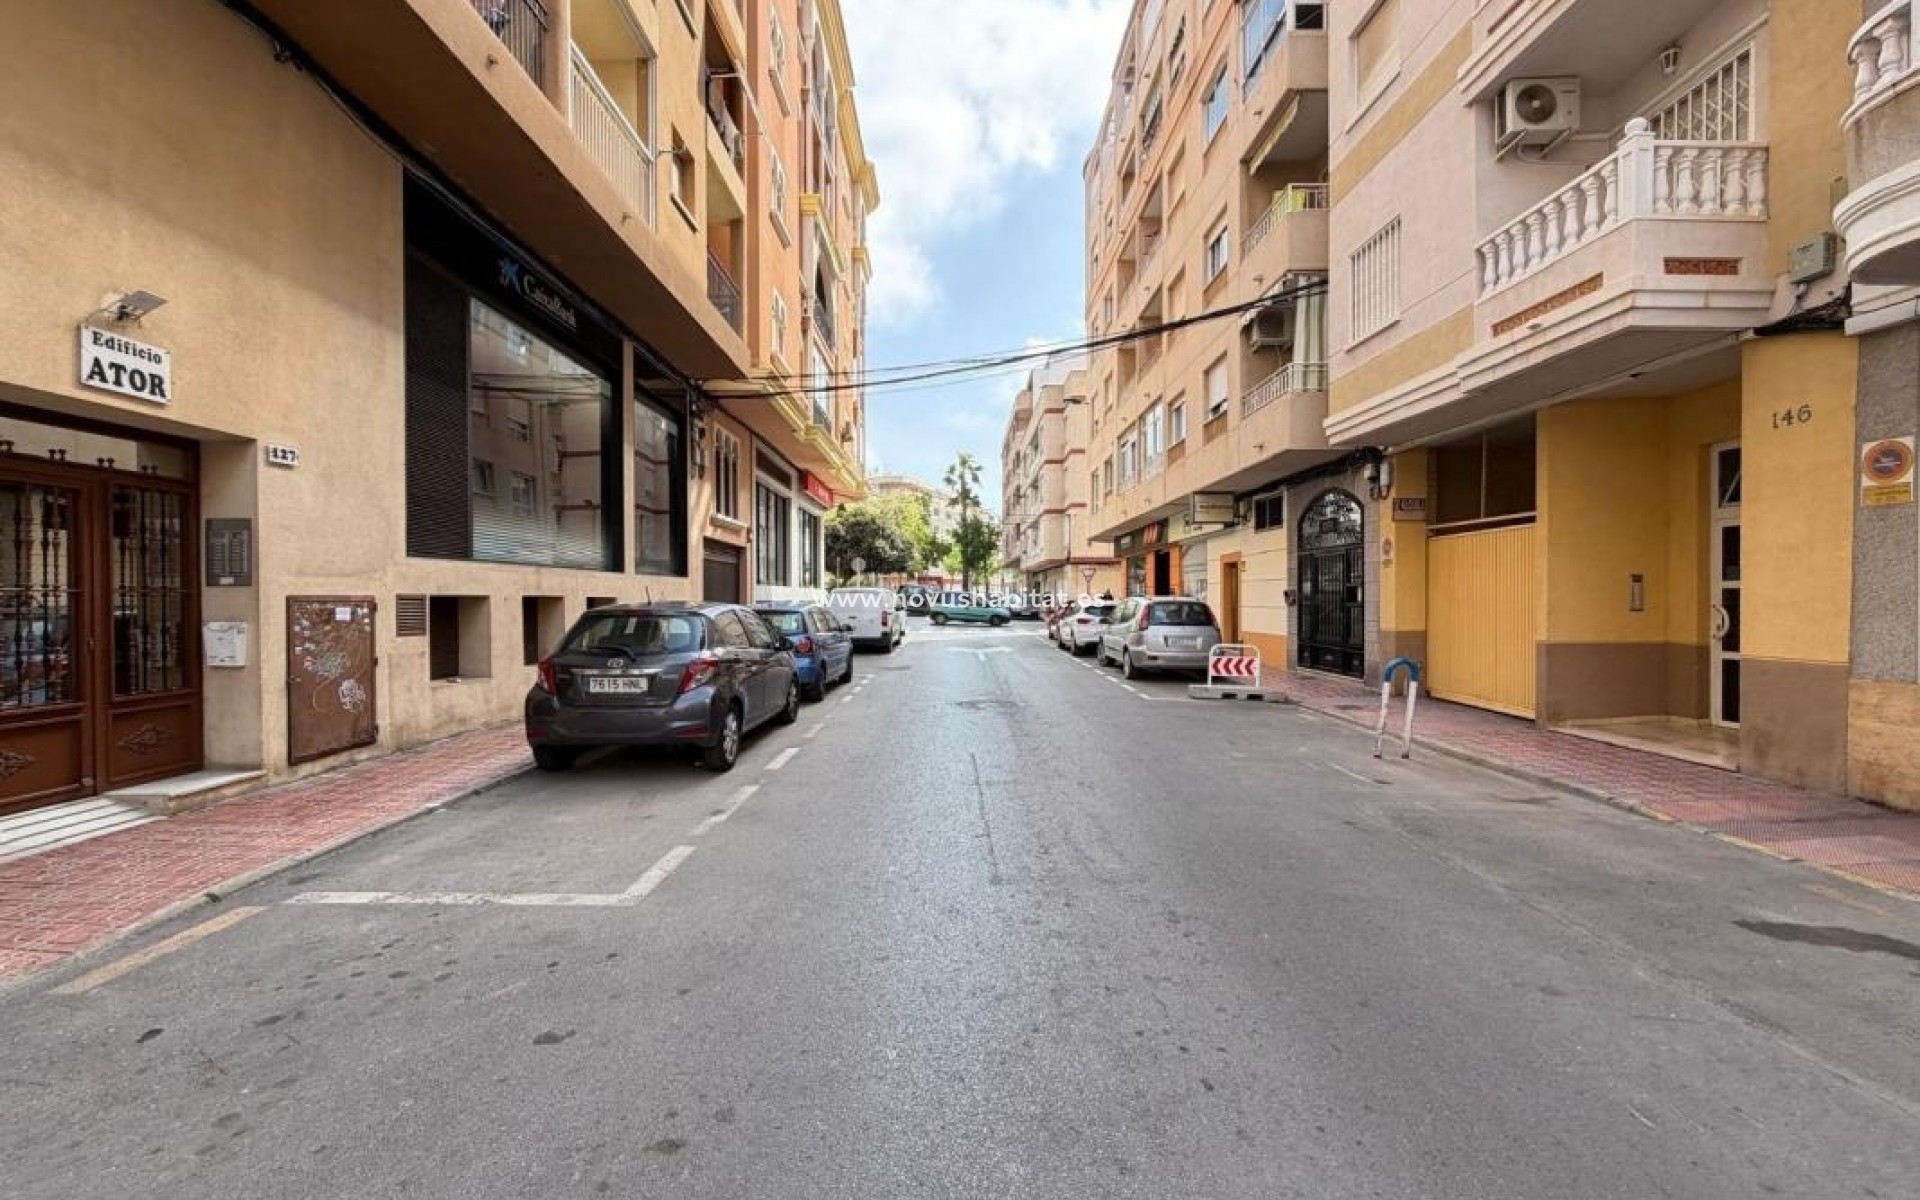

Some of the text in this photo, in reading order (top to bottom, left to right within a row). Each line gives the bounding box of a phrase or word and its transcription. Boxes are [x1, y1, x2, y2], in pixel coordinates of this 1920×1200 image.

[92, 330, 162, 365] Edificio
[86, 355, 166, 397] ATOR
[1772, 404, 1812, 429] 146
[271, 447, 296, 463] 127
